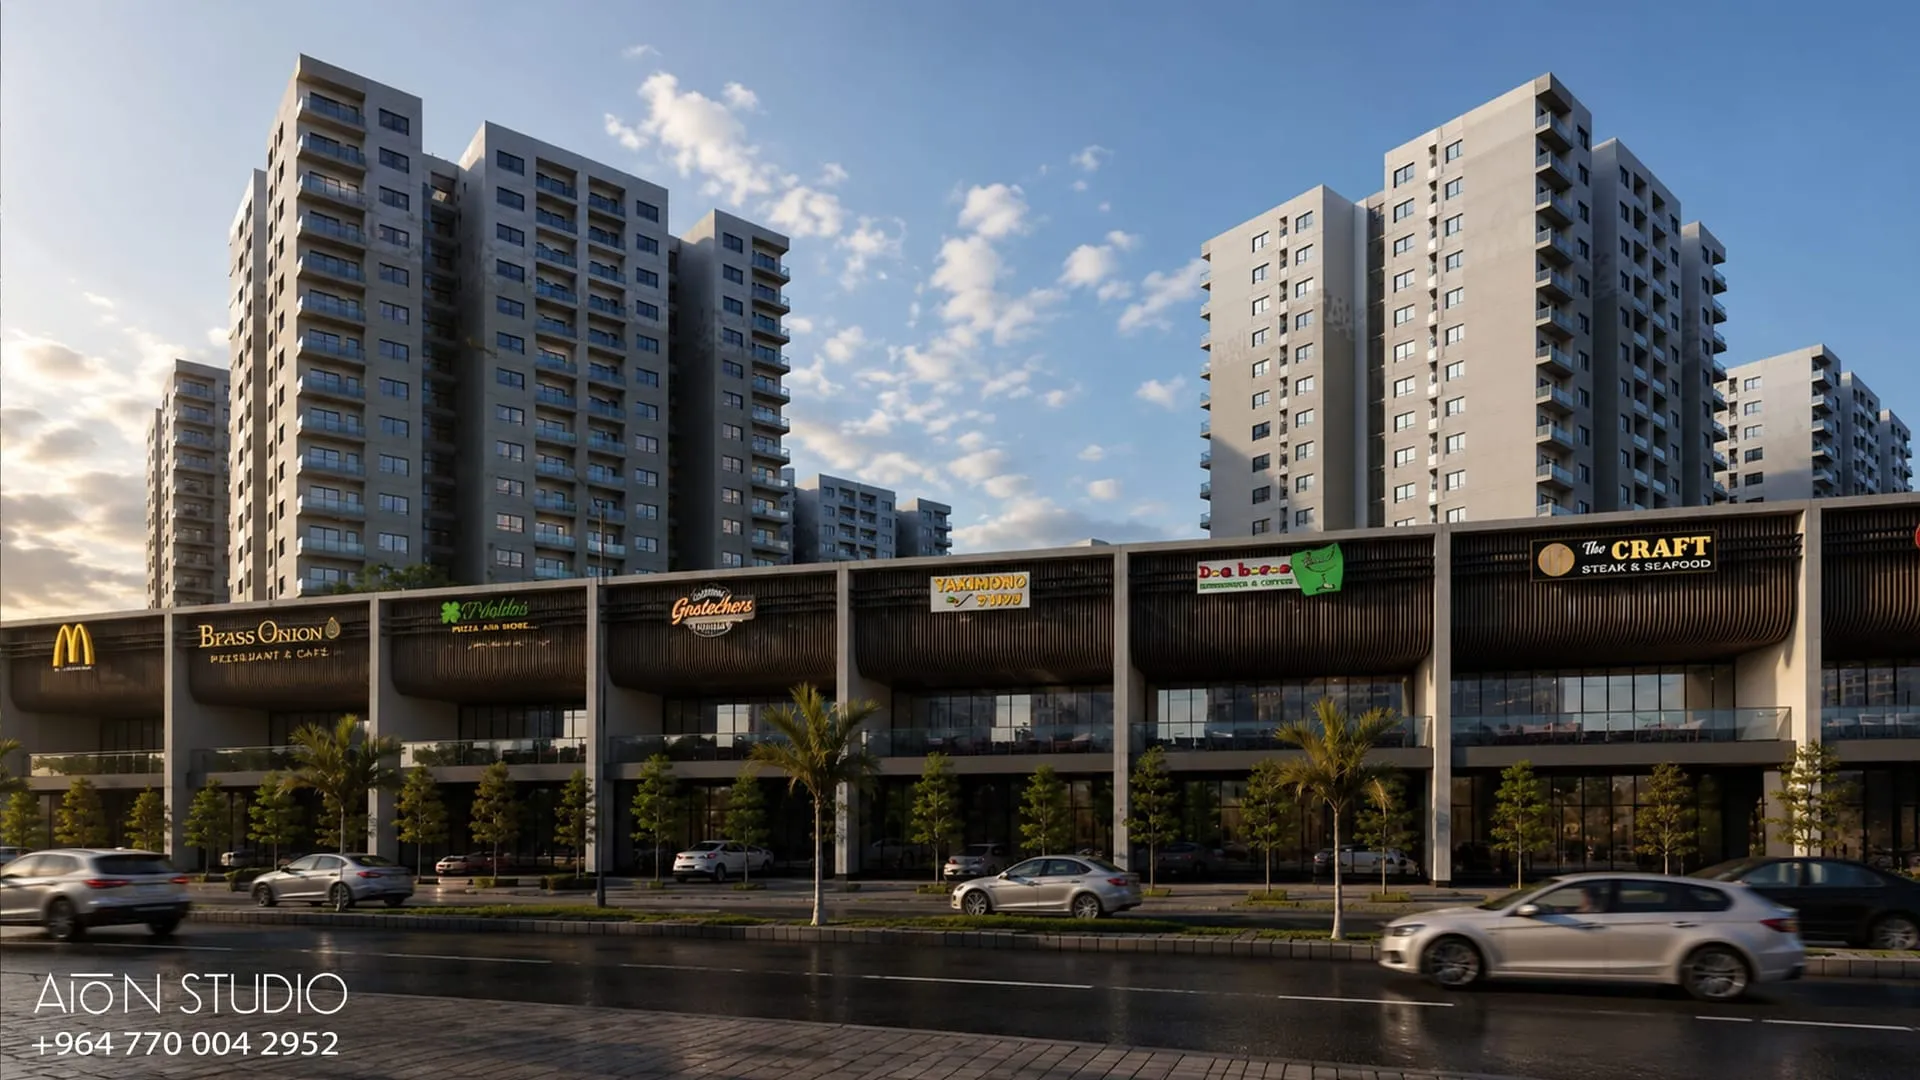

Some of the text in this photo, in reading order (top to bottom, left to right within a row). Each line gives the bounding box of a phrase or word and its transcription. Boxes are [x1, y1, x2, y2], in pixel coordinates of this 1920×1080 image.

[1582, 536, 1711, 560] The CRAFT
[1582, 559, 1711, 574] STEAK & SEAFOOD
[258, 620, 323, 643] ONION
